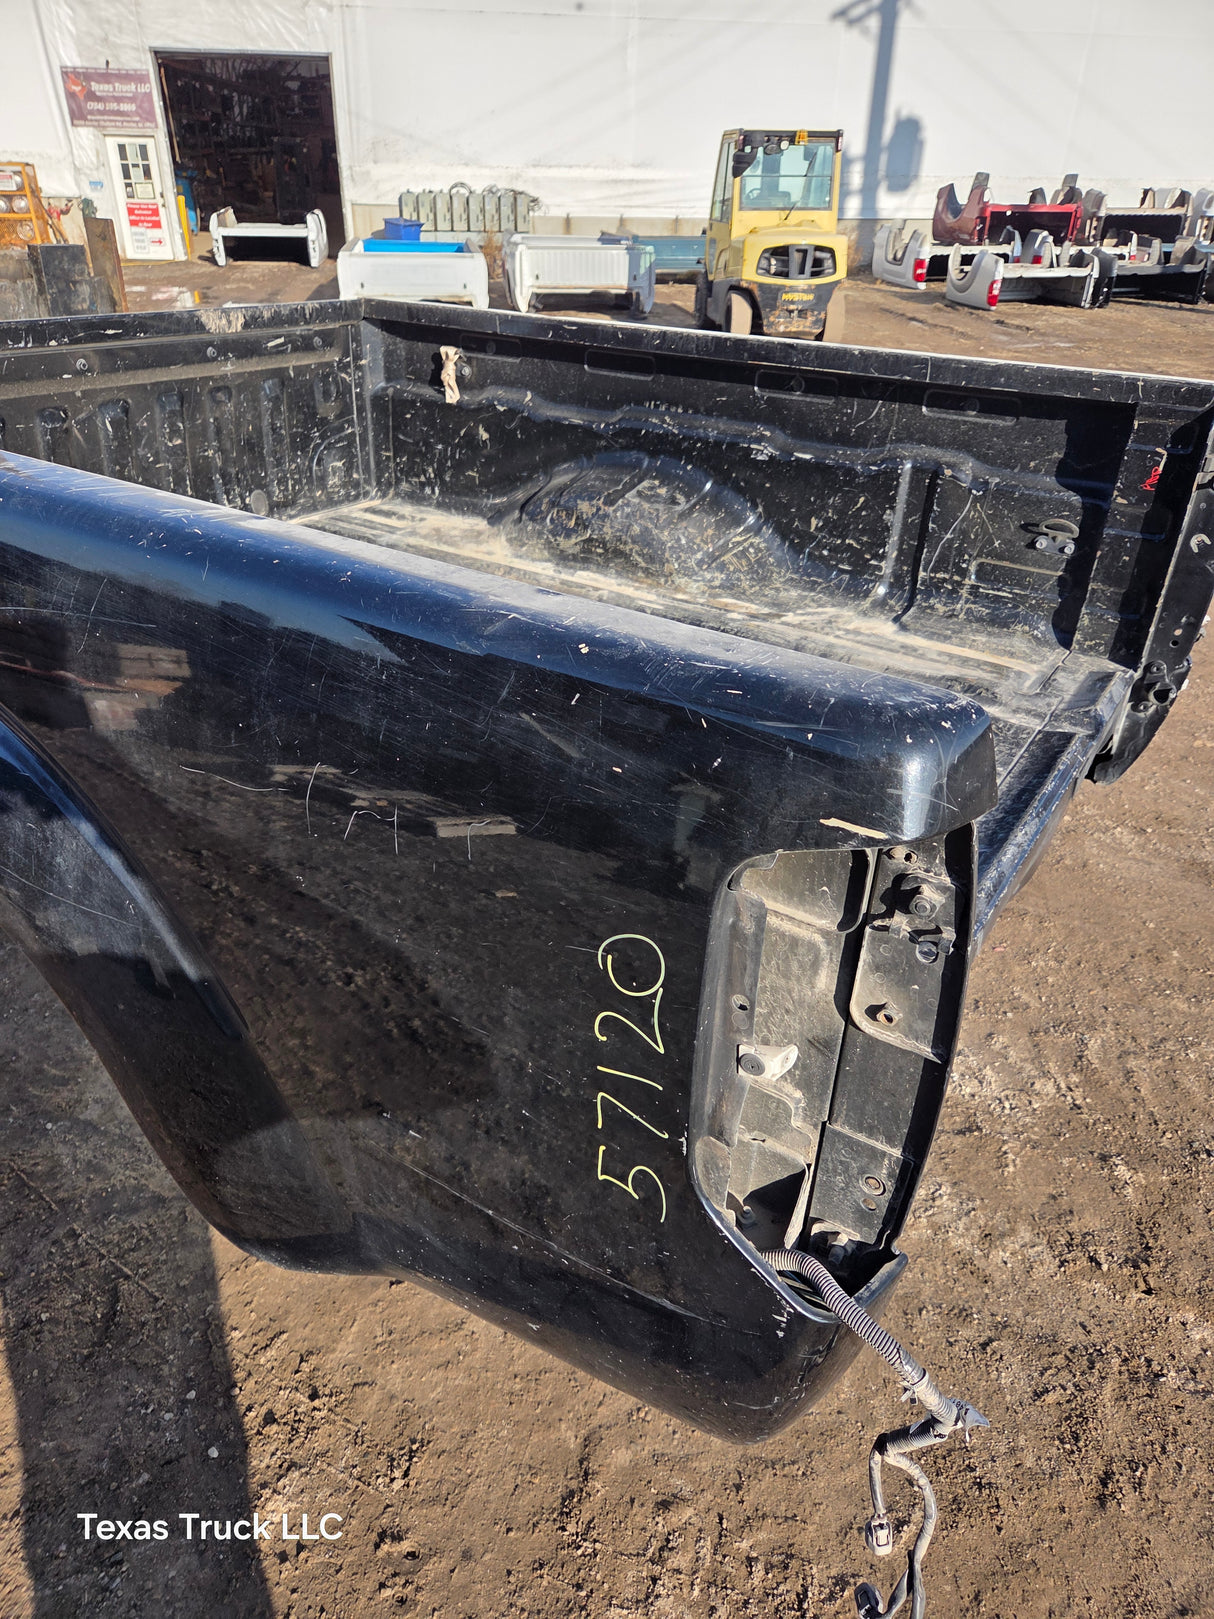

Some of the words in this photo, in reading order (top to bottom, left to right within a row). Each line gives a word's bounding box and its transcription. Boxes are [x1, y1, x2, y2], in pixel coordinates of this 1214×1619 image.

[90, 81, 113, 92] Texas
[115, 82, 136, 92] Truck
[137, 83, 151, 93] LLC
[594, 933, 669, 1223] 57120
